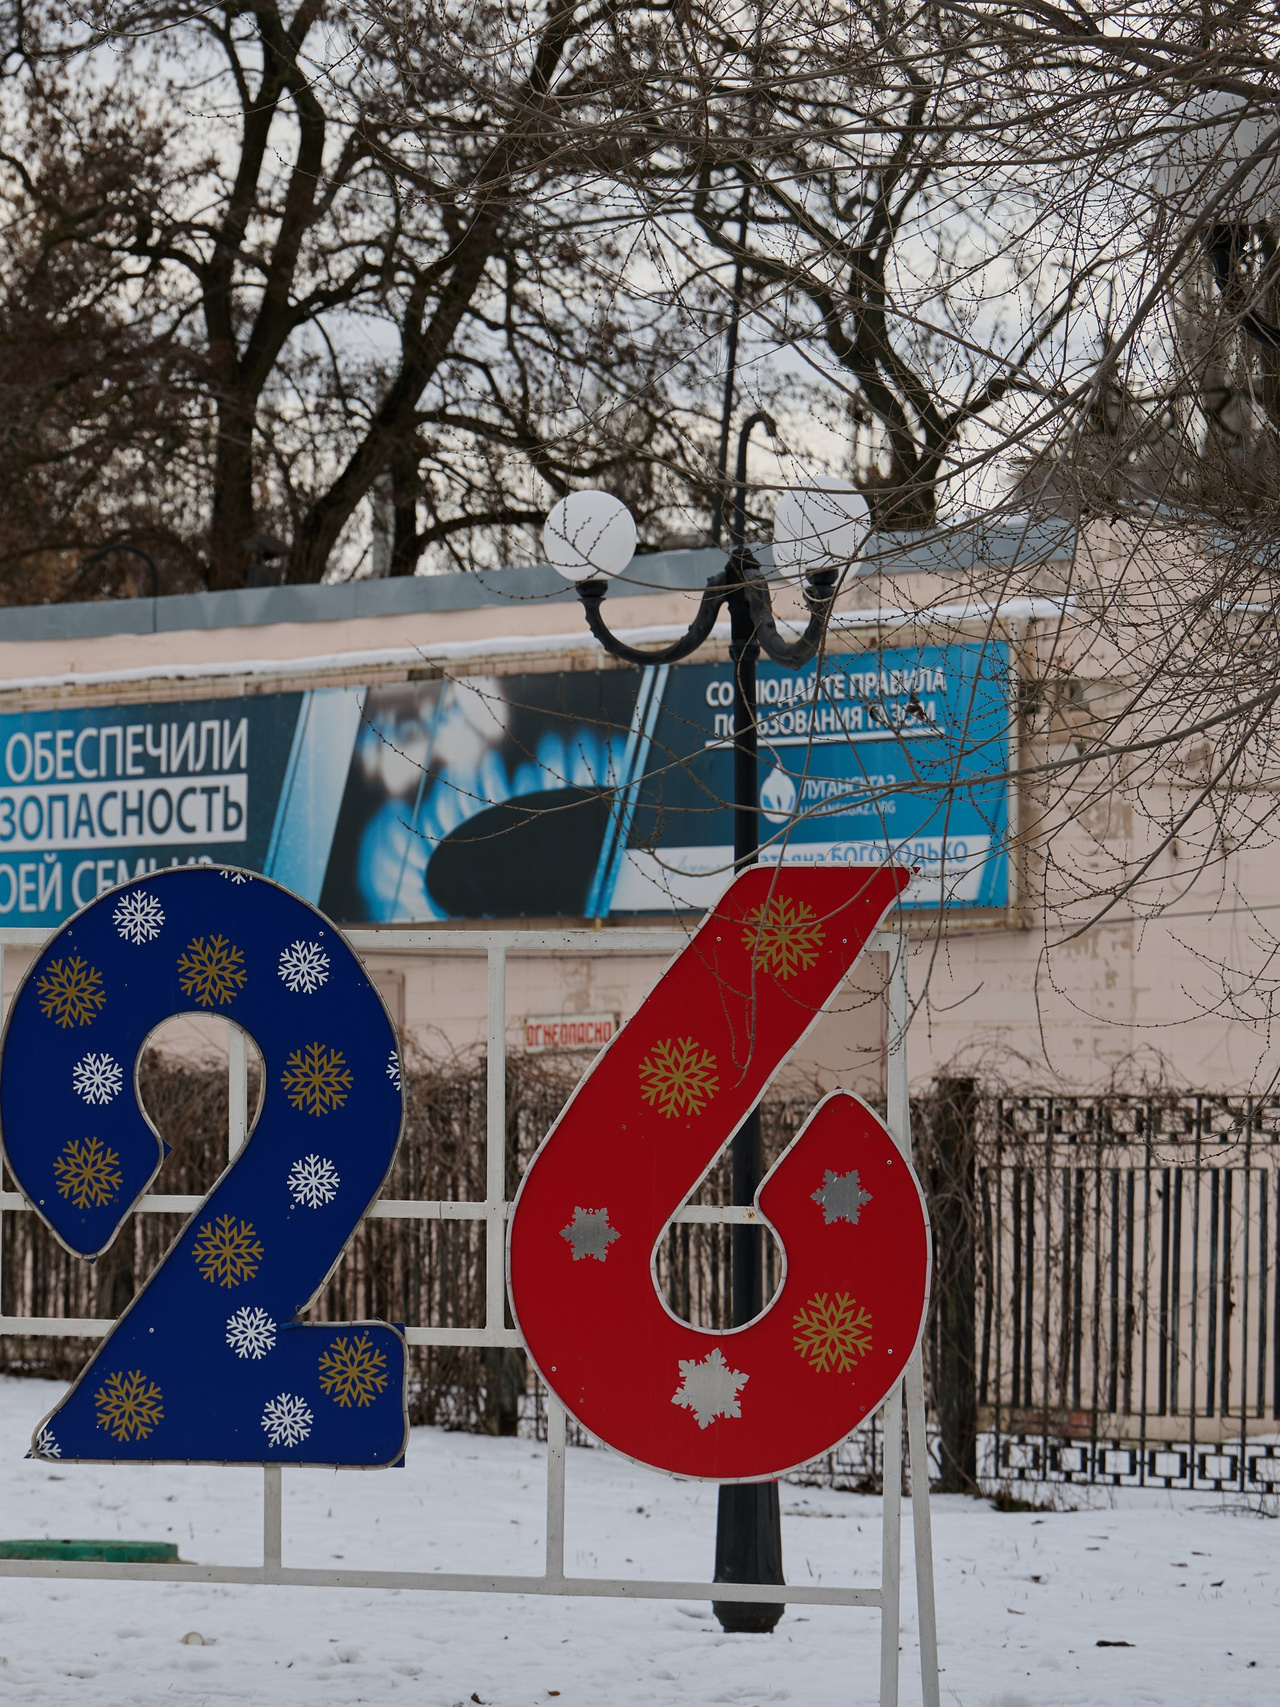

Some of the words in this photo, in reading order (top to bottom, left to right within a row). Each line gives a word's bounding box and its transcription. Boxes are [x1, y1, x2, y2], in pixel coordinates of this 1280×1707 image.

[705, 671, 845, 708] СОЮДАЙТЕ
[849, 666, 947, 698] ПРАВИЛА
[714, 705, 863, 738] ПЬЗОВАНИЯ
[5, 717, 249, 783] ОБЕСПЕЧИЛИ
